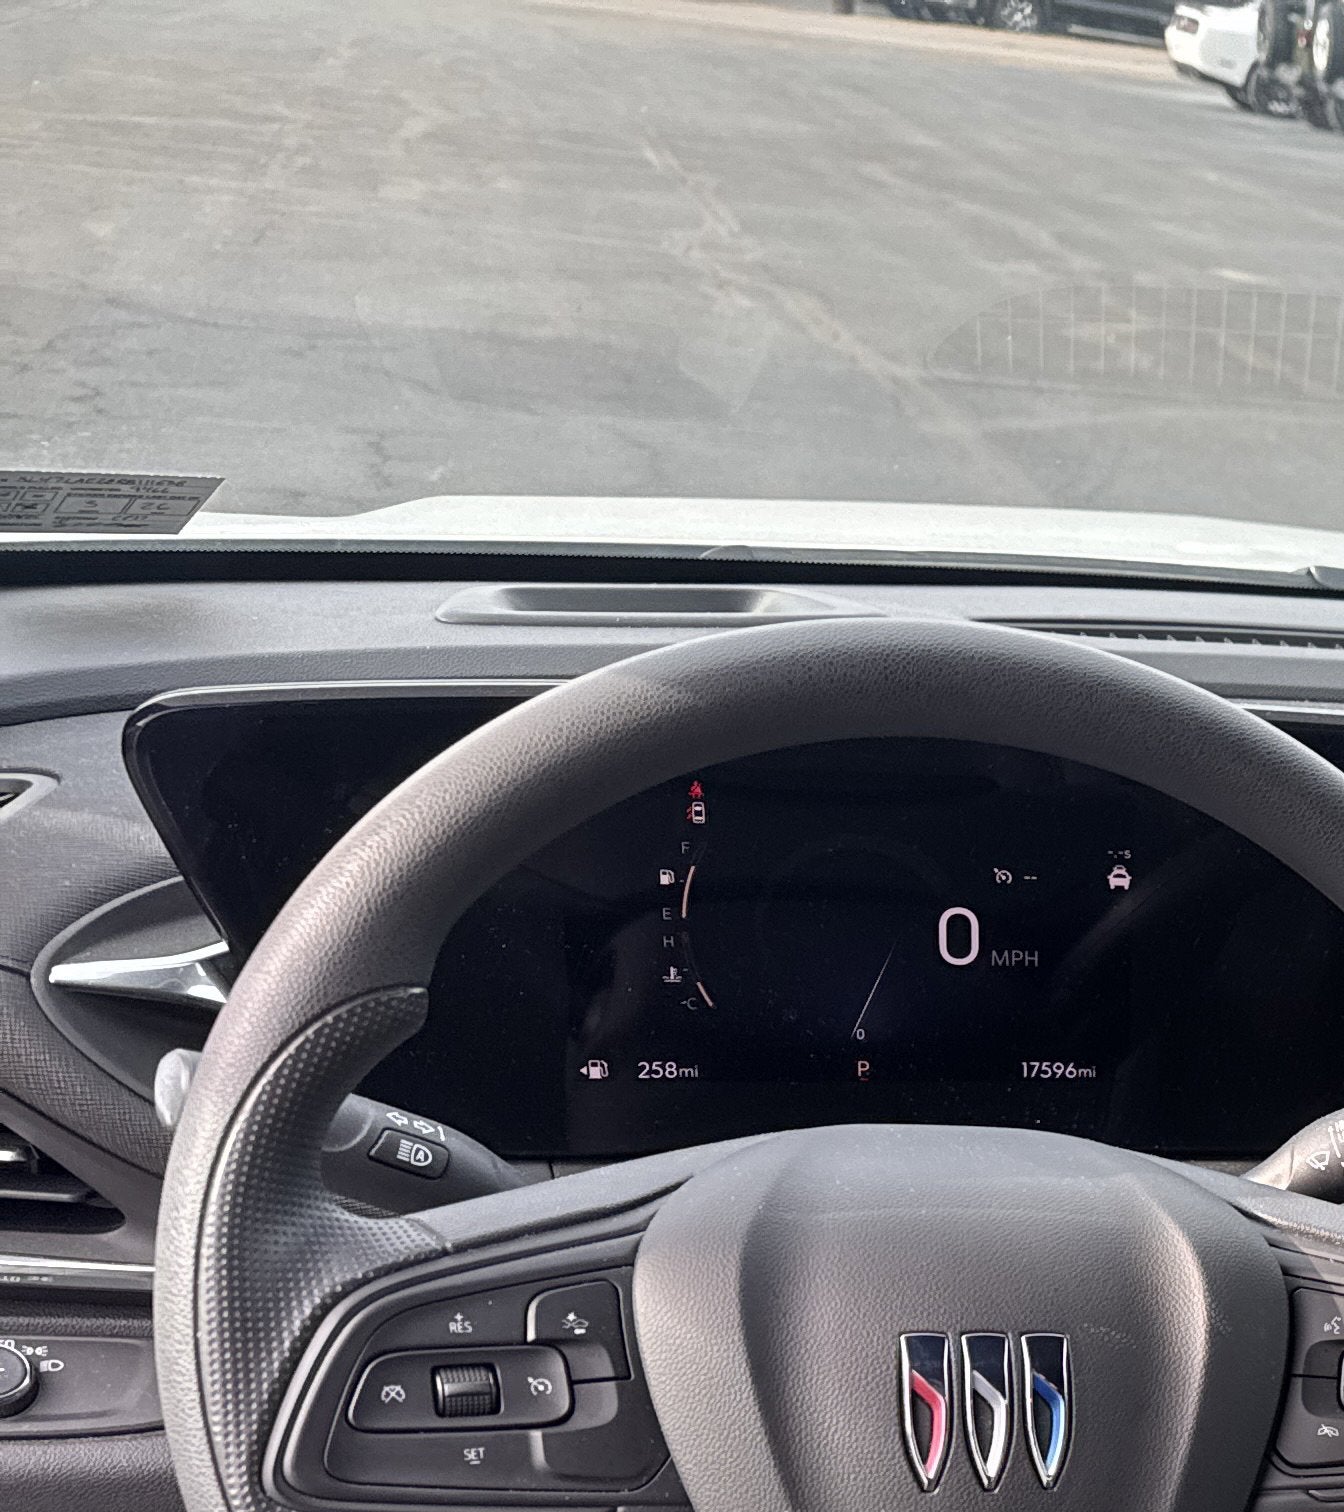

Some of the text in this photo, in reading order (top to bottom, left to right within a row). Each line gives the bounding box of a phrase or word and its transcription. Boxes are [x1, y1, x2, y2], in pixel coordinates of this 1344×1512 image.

[681, 841, 690, 854] F
[662, 907, 672, 920] E
[663, 936, 674, 947] H
[938, 906, 1039, 967] 0 MPH
[857, 1061, 869, 1077] P
[449, 1320, 473, 1334] RES
[464, 1447, 485, 1460] SET
